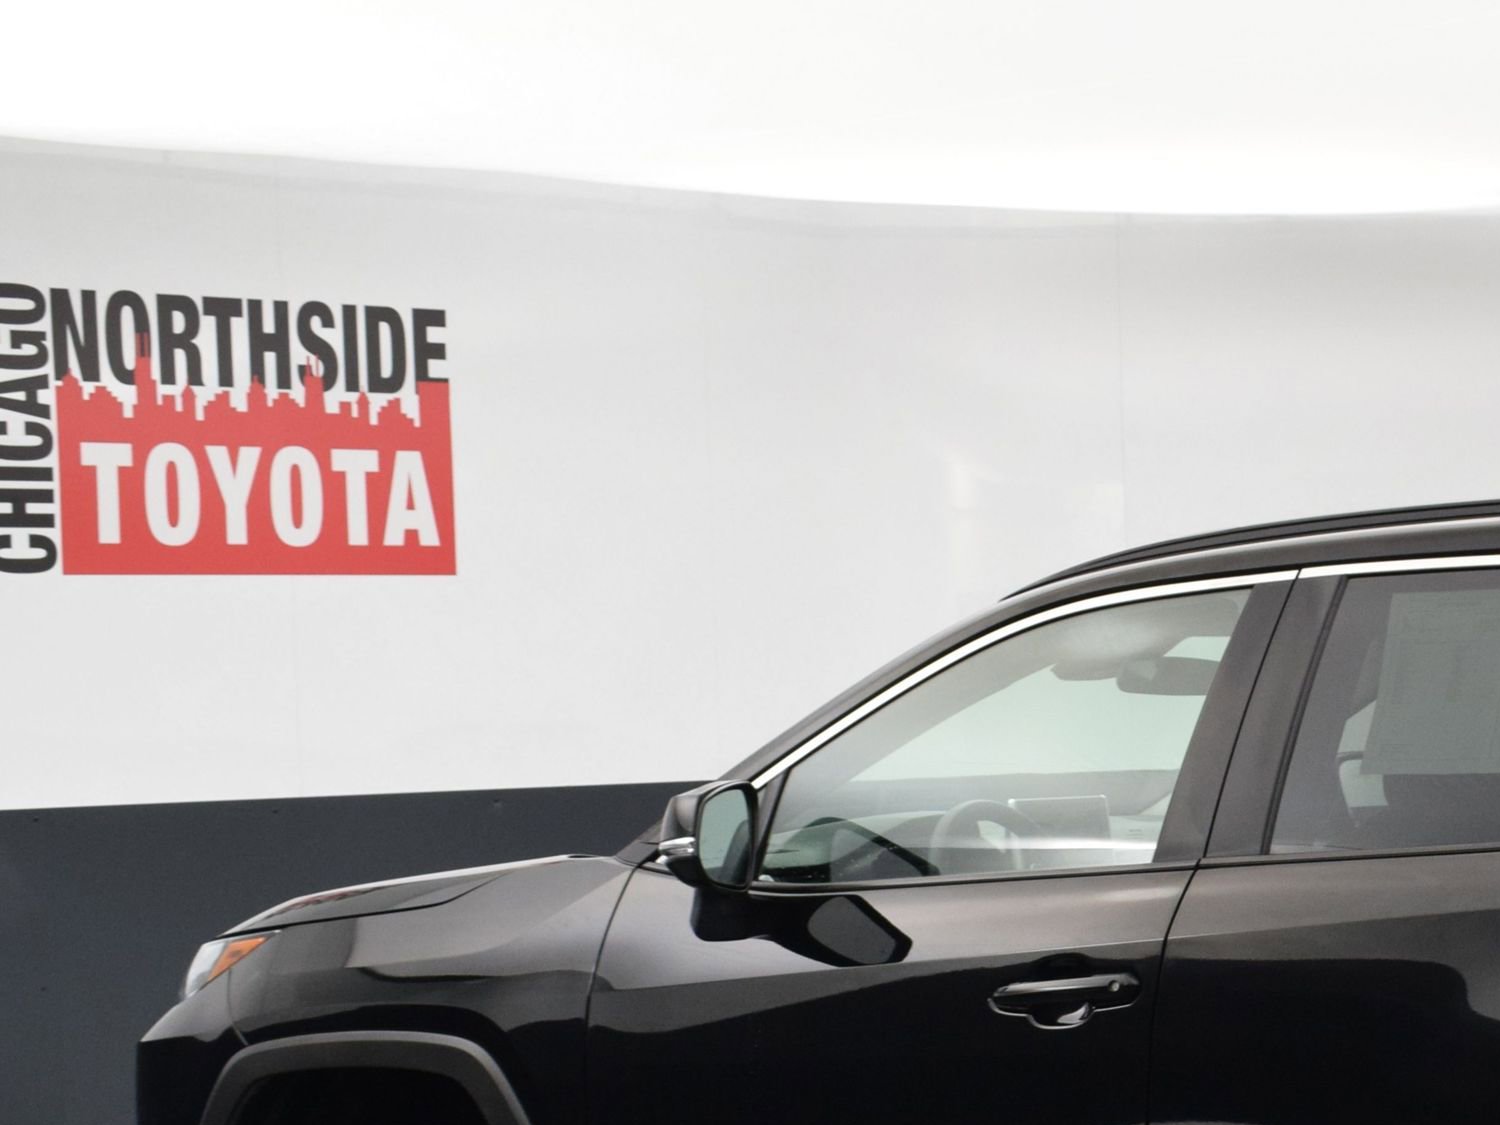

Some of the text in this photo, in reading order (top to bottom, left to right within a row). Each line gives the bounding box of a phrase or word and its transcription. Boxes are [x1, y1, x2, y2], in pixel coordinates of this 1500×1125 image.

[50, 288, 447, 394] NORTHSIDE
[0, 282, 57, 574] CHICAGO
[80, 442, 441, 547] TOYOTA
